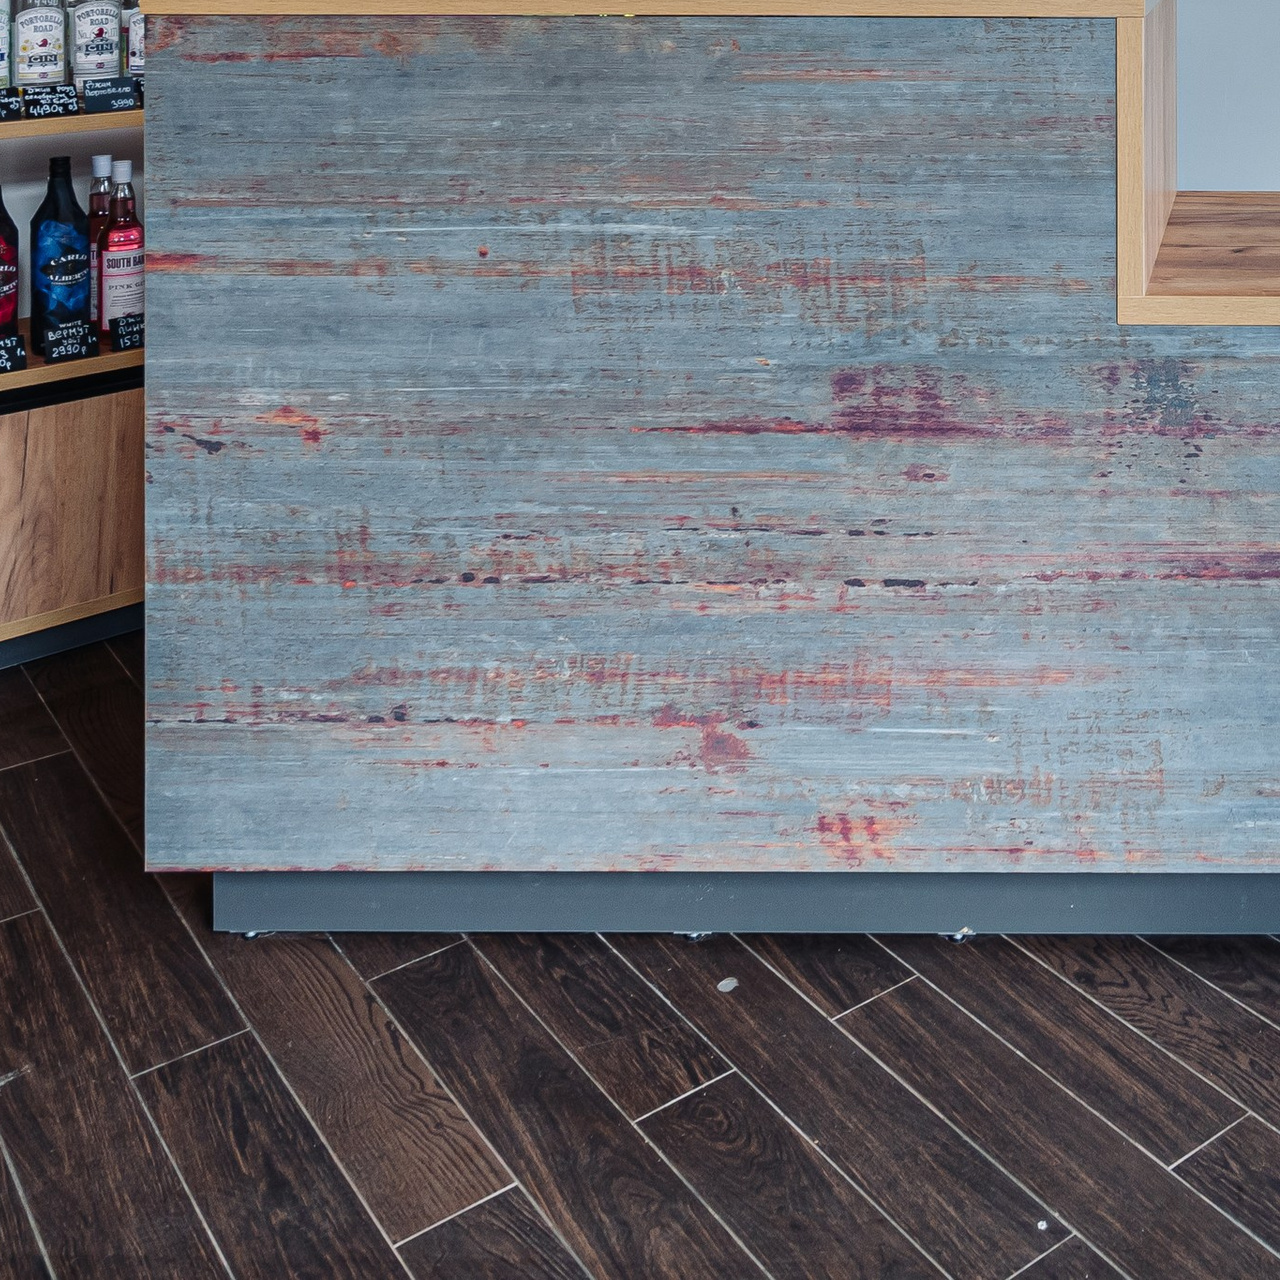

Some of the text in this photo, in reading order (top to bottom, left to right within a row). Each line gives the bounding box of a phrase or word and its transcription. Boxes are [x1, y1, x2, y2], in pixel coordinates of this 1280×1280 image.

[90, 18, 109, 26] ROAD
[33, 24, 54, 33] ROAD
[87, 43, 112, 51] GIN
[31, 54, 57, 62] GIN
[110, 98, 135, 109] 3990
[50, 253, 88, 266] CARLO
[106, 257, 131, 269] SOUTH
[108, 283, 133, 291] PINK
